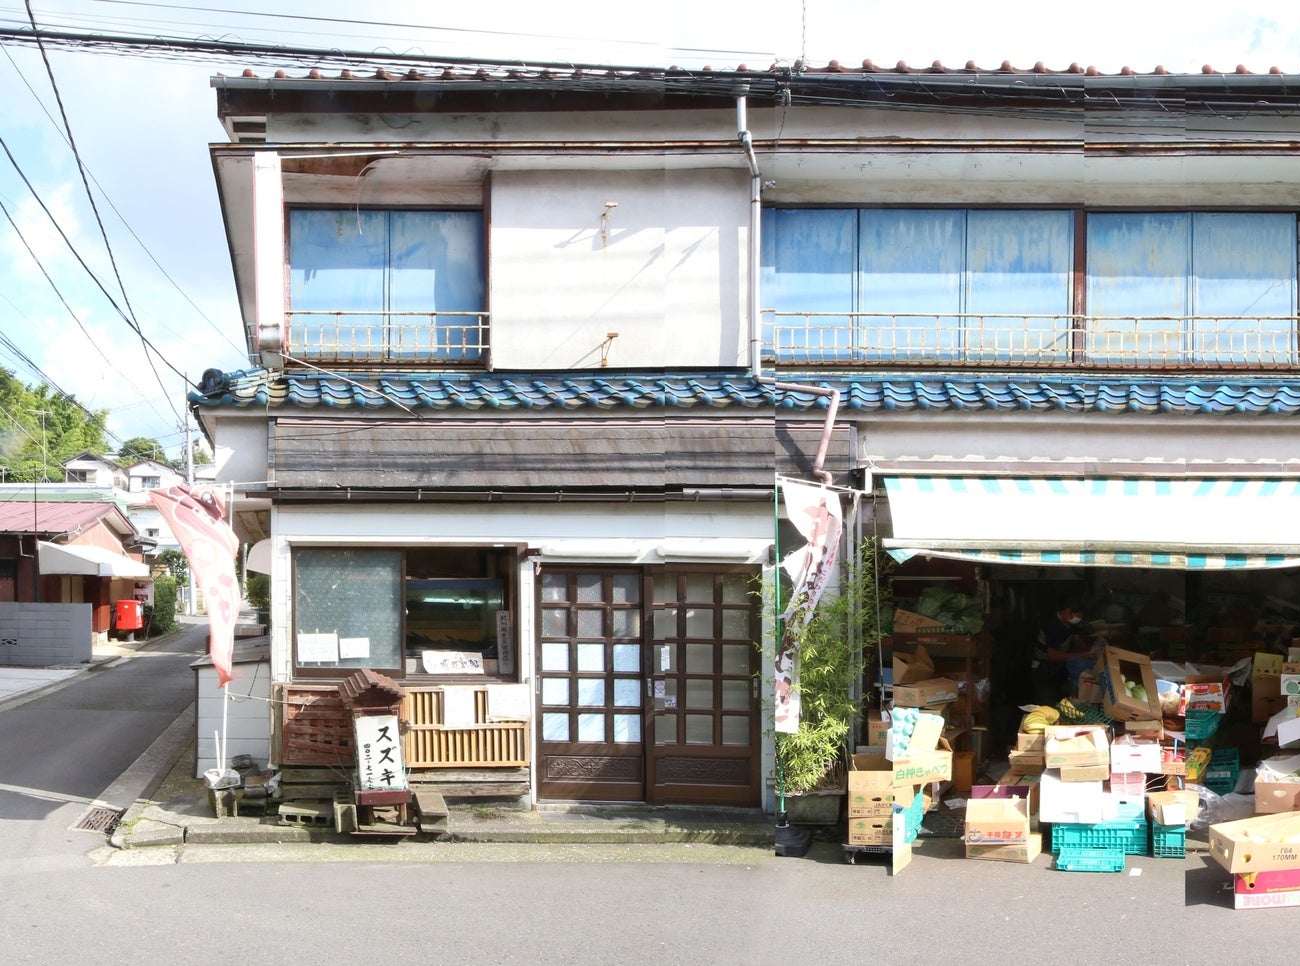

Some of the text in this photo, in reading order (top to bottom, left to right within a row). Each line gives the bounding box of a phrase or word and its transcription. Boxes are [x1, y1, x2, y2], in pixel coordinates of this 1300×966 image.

[376, 725, 397, 786] スズキ
[895, 764, 948, 781] 白神きゃべつ
[1272, 854, 1298, 862] 170MM
